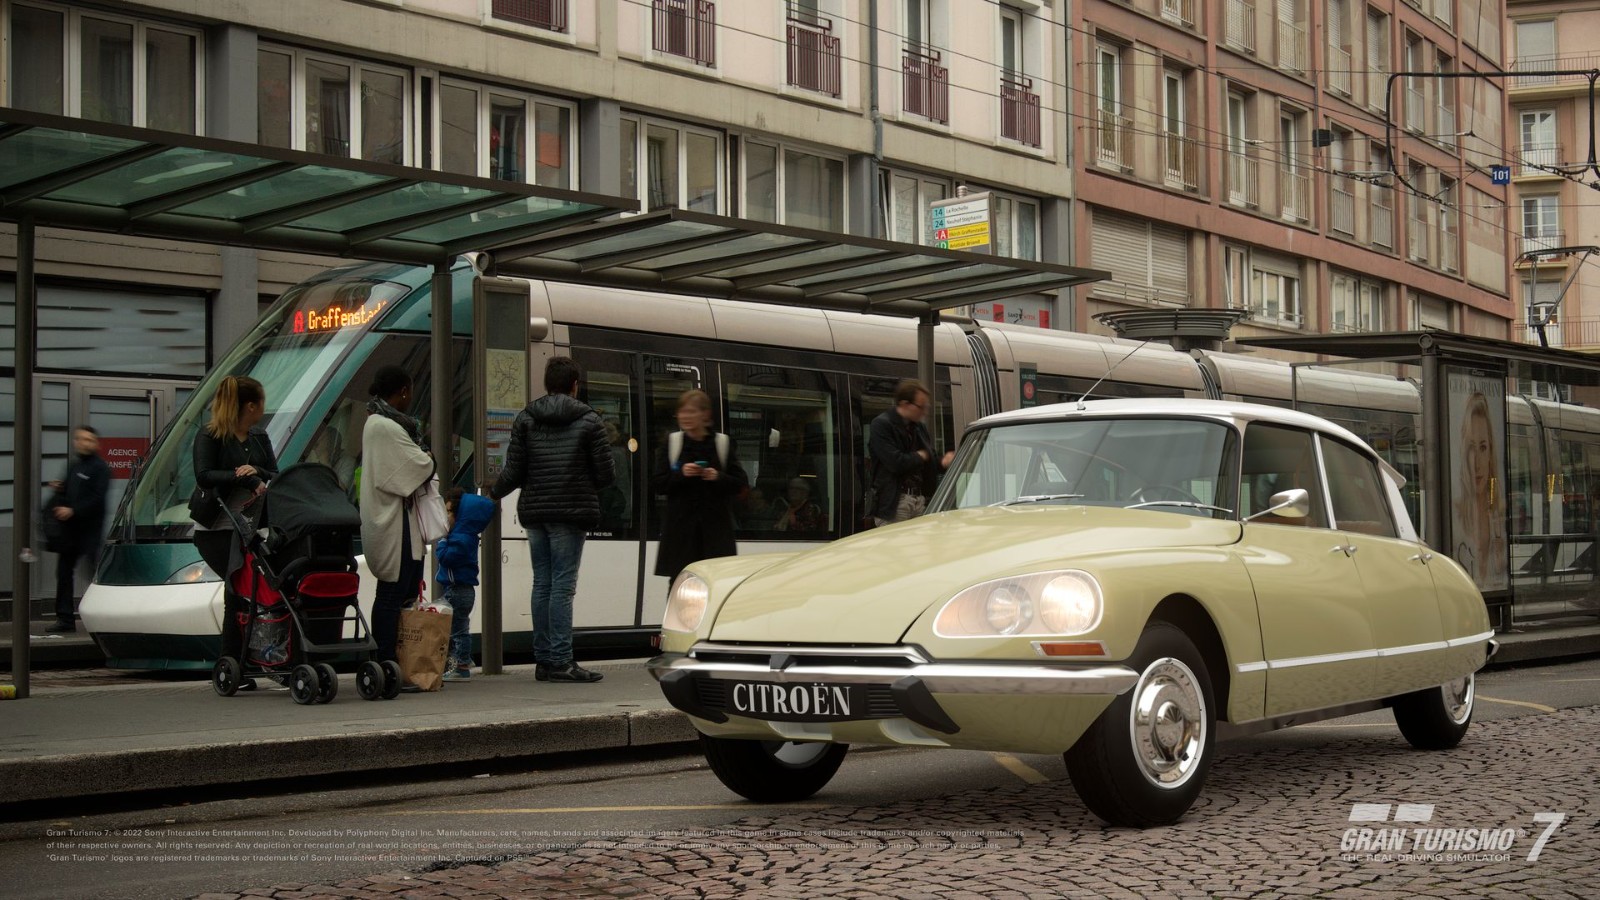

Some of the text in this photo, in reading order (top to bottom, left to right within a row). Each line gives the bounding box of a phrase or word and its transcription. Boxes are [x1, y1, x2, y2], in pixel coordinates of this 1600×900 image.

[1493, 170, 1509, 180] 101
[933, 208, 943, 216] 14
[935, 219, 944, 228] 24
[940, 230, 946, 240] A
[293, 310, 305, 333] A
[733, 682, 851, 716] CITROËN
